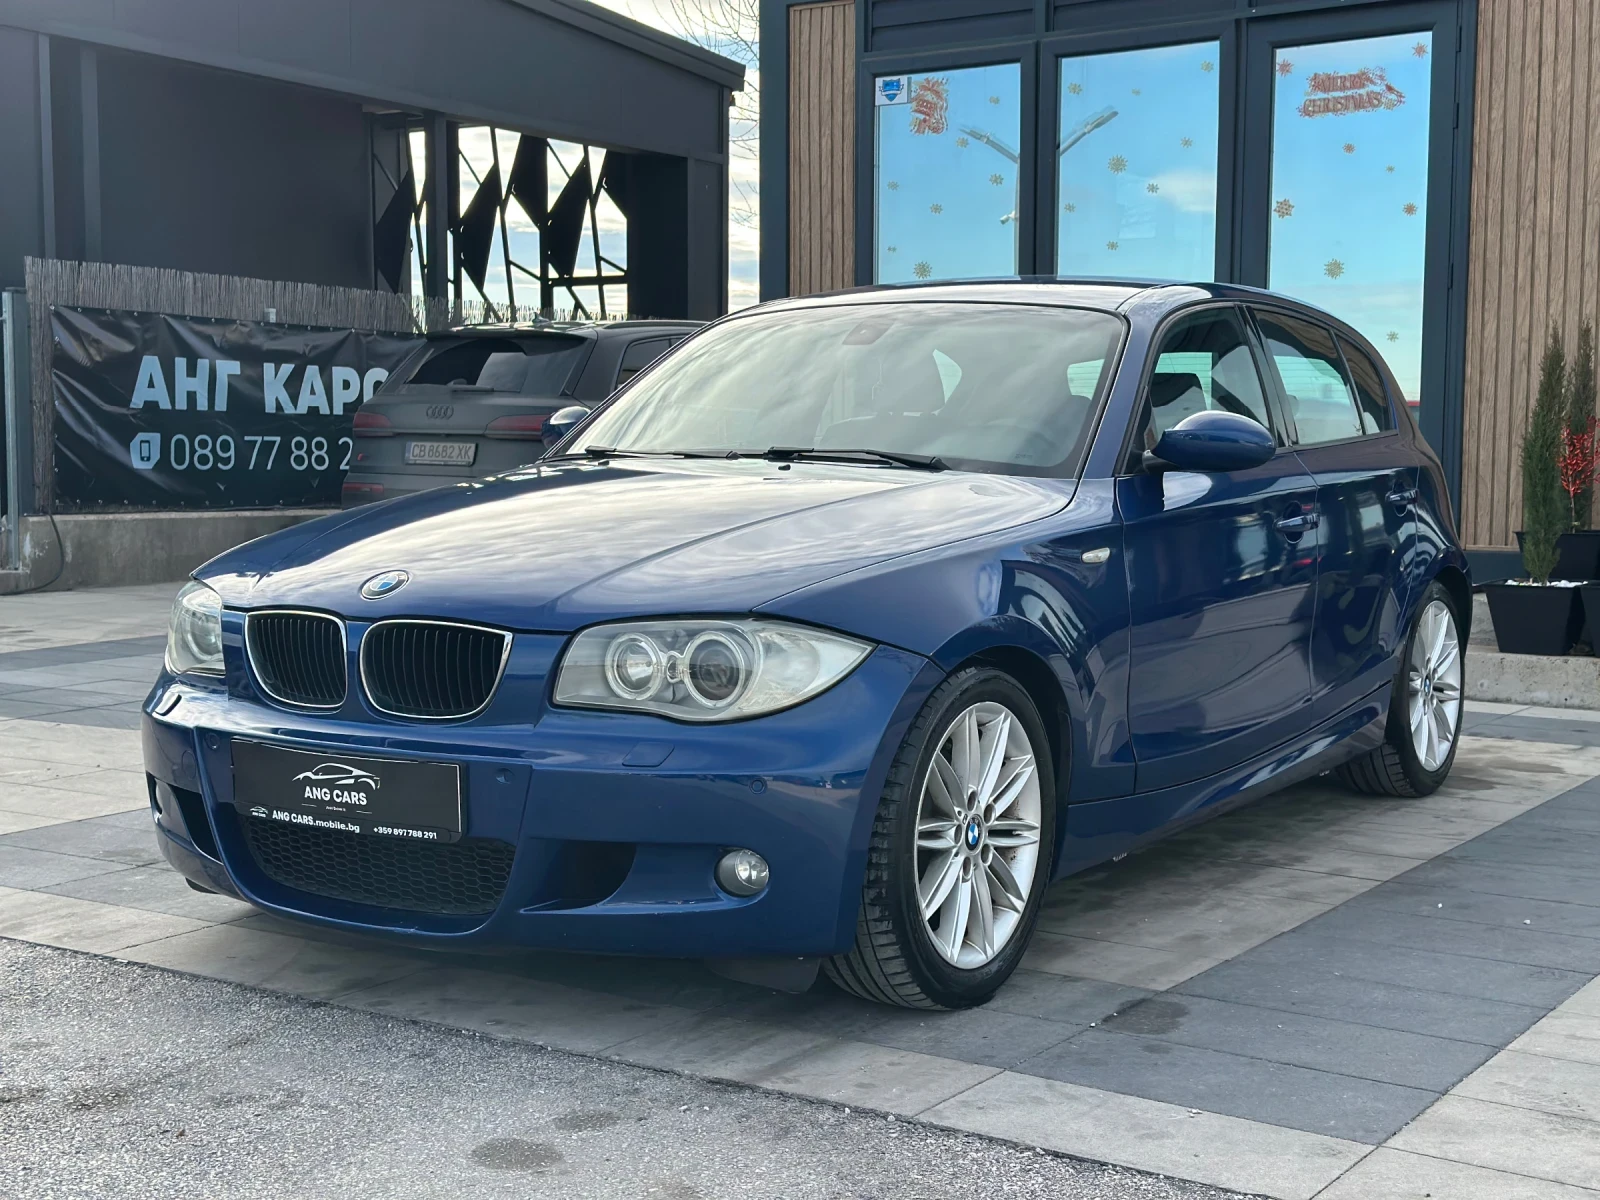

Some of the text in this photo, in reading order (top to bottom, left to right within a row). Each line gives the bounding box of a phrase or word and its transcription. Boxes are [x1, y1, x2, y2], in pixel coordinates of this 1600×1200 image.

[129, 355, 241, 412] АНГ
[170, 433, 235, 471] 089
[244, 435, 281, 470] 77
[290, 436, 329, 471] 88
[428, 444, 455, 459] 8682
[304, 785, 331, 801] ANG
[332, 789, 368, 806] CARS
[272, 809, 291, 822] ANG
[291, 813, 360, 834] CARS.mobile.bg
[373, 826, 437, 840] +359 897 788 291
